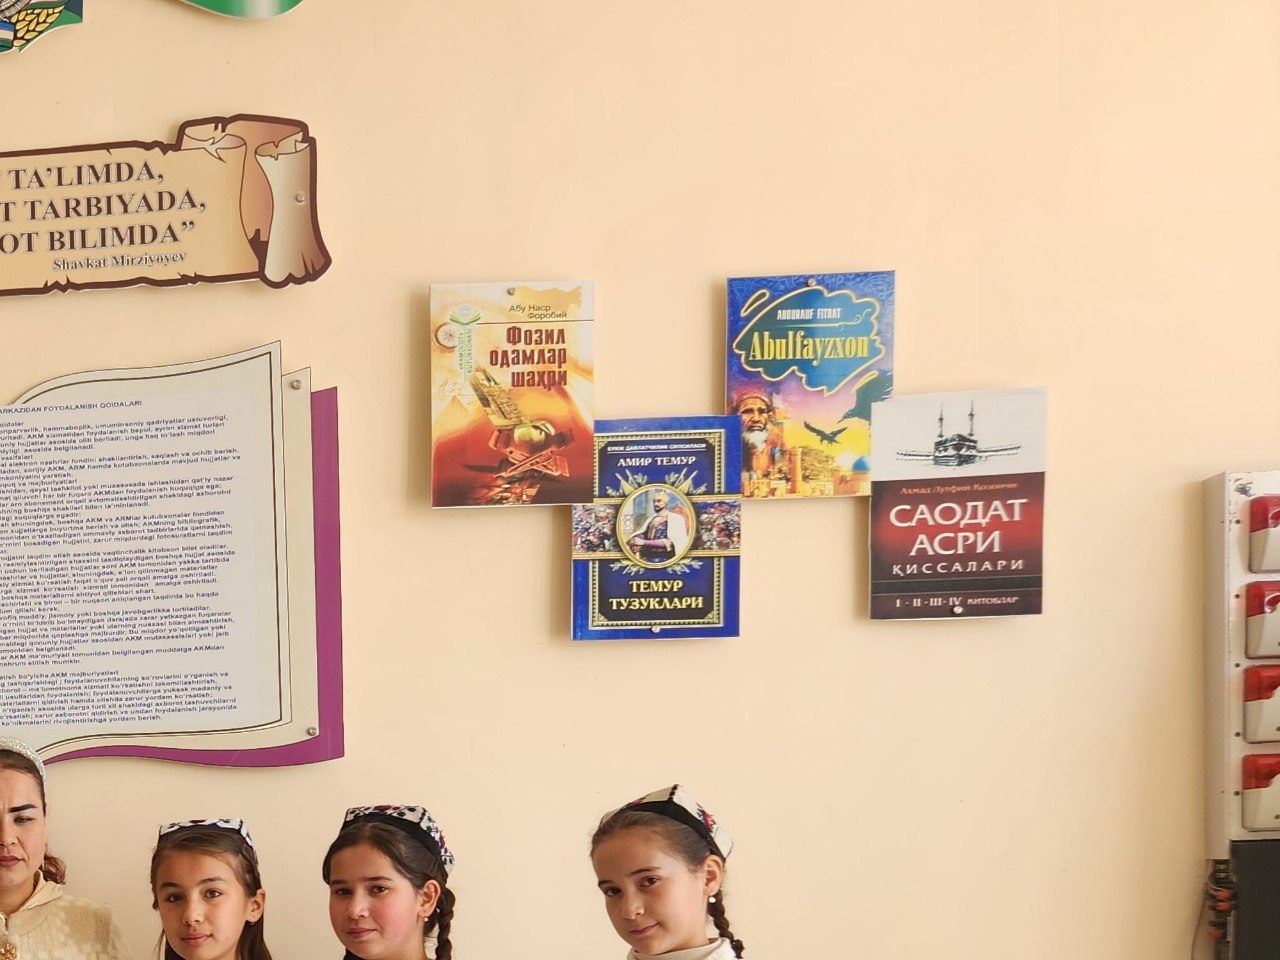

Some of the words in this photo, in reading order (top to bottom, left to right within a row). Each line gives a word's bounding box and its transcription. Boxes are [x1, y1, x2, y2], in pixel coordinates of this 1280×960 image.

[9, 161, 163, 190] TA’LIMDA,
[24, 190, 206, 221] TARBIYADA,
[48, 220, 195, 251] BILIMDA”
[53, 256, 106, 271] Shavkat
[113, 253, 186, 269] Mirziyoyev
[509, 305, 525, 313] Абу
[529, 304, 550, 313] Наср
[527, 312, 567, 320] Форобий
[817, 308, 842, 319] FITRAT
[507, 326, 566, 345] Фозил
[749, 330, 869, 366] Abulfayzxon
[490, 348, 566, 368] одамлар
[511, 370, 567, 391] шаҳри
[43, 403, 98, 412] FOYDALANISH
[100, 400, 142, 409] QOIDALARI
[618, 458, 652, 466] АМИР
[655, 456, 696, 465] ТЕМУР
[889, 498, 1029, 528] САОДАТ
[909, 530, 1001, 556] АСРИ
[892, 559, 1023, 577] ҚИССАЛАРИ
[629, 580, 683, 592] ТЕМУР
[609, 597, 703, 610] ТУЗУКЛАРИ
